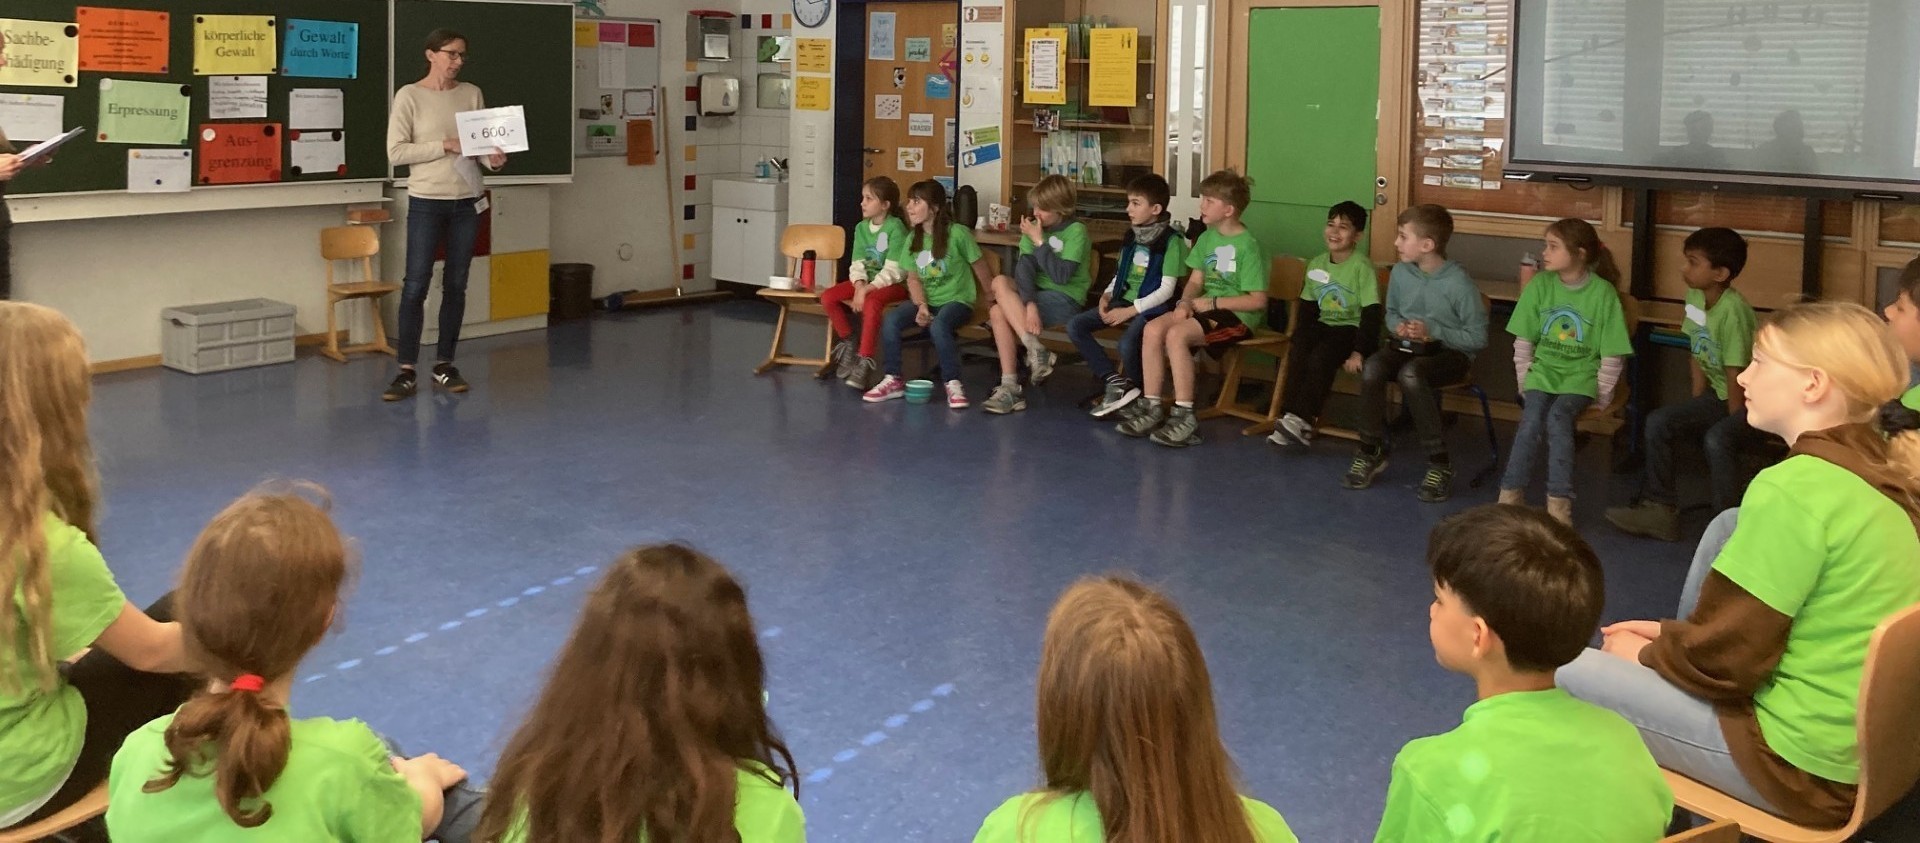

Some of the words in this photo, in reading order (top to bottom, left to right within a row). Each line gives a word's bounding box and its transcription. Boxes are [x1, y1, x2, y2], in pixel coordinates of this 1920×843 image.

[4, 29, 55, 46] Sachbe-
[204, 30, 266, 44] körperliche
[299, 29, 346, 45] Gewalt
[215, 46, 255, 57] Gewalt
[290, 47, 318, 58] durch
[321, 48, 350, 60] Worte
[3, 54, 65, 73] hädigung
[108, 102, 178, 120] Erpressung
[224, 134, 258, 148] Aus-
[208, 156, 272, 172] grenzung
